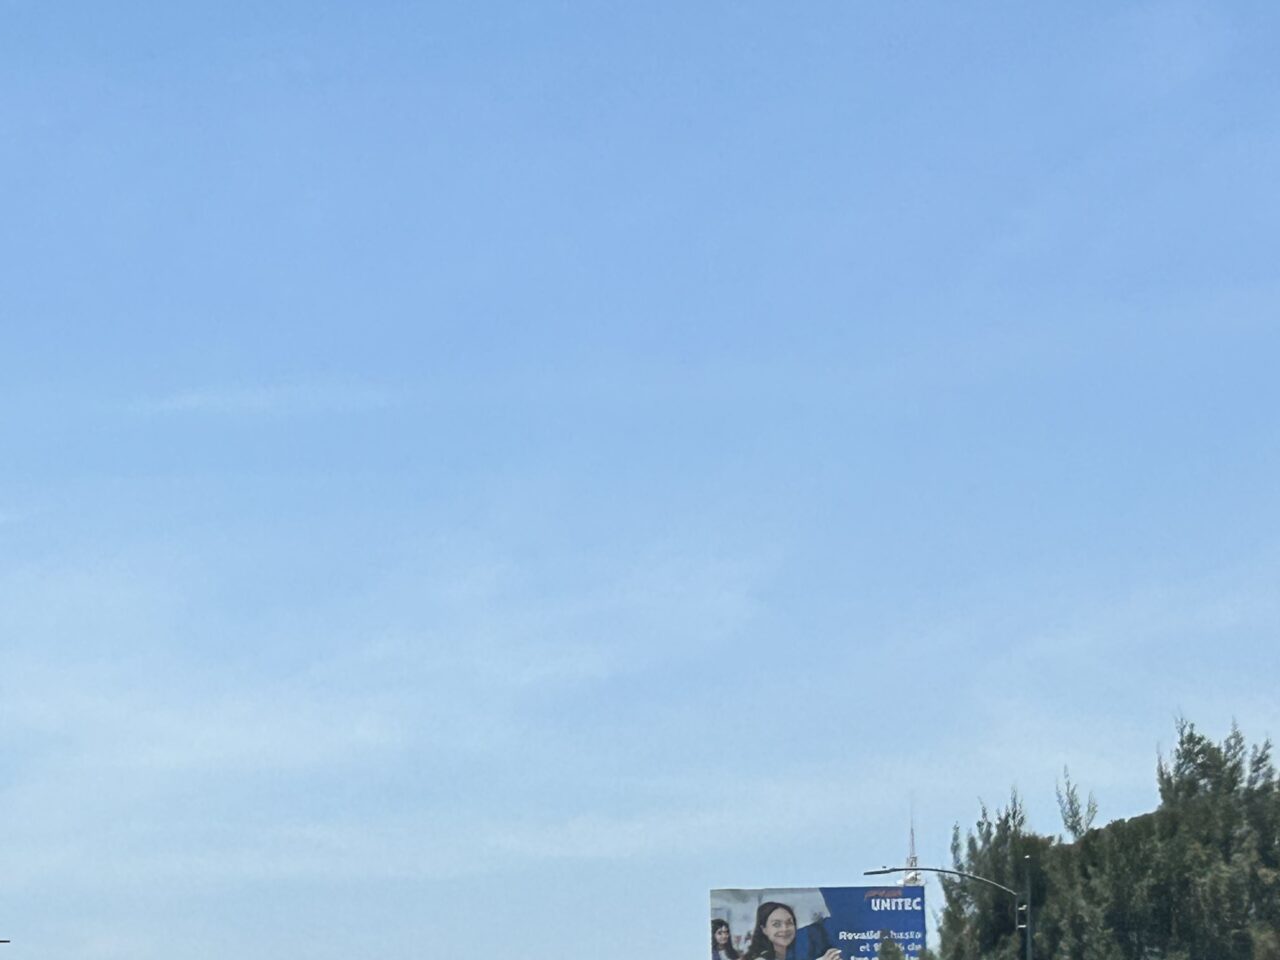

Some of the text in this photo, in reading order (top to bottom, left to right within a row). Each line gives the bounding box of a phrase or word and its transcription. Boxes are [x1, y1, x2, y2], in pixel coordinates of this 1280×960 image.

[871, 898, 922, 911] UNITEC
[838, 930, 889, 940] Revalid
[859, 943, 871, 952] el
